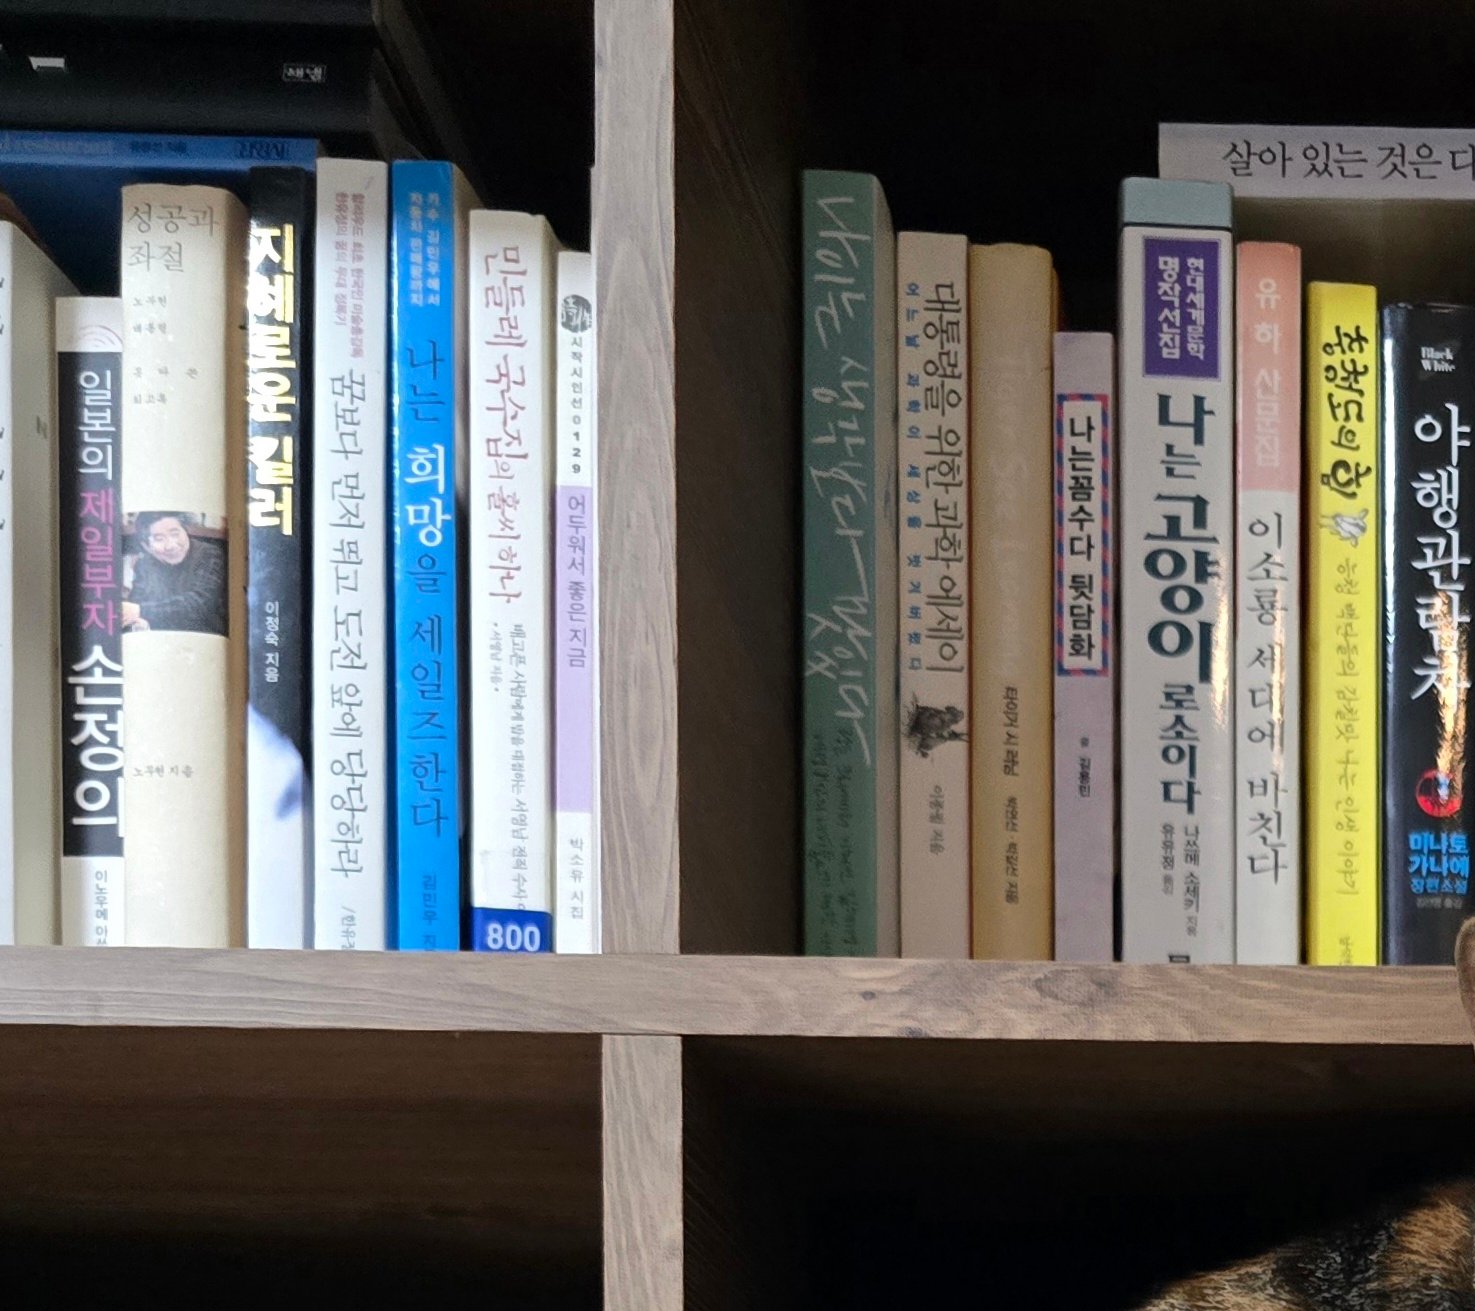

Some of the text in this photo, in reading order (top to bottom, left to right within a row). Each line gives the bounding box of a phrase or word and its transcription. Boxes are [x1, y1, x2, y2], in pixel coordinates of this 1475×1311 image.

[1222, 141, 1291, 180] 살아
[1302, 142, 1368, 182] 있는
[1375, 144, 1442, 181] 것은
[127, 202, 219, 237] 성공과
[127, 242, 185, 273] 좌절
[485, 246, 529, 481] 민들레 국수집의
[1323, 325, 1369, 452] 충청도의
[1421, 347, 1455, 360] Black
[1421, 361, 1456, 373] White
[923, 283, 965, 673] 대통령을 위한 과학 에세이
[1157, 394, 1216, 479] 나는
[67, 371, 125, 838] 일본의 제일부자 손정의
[330, 369, 367, 878] 꿈보다 먼저 도전 앞에 당당하라
[405, 340, 451, 838] 나는 희망을 세일즈한다
[567, 496, 587, 669] 어두워서 좋은 지금
[1068, 573, 1095, 661] 뒷담화
[1247, 772, 1288, 885] 바친다
[1409, 831, 1468, 853] 미나토
[1409, 855, 1470, 877] 가나에
[486, 925, 541, 950] 800
